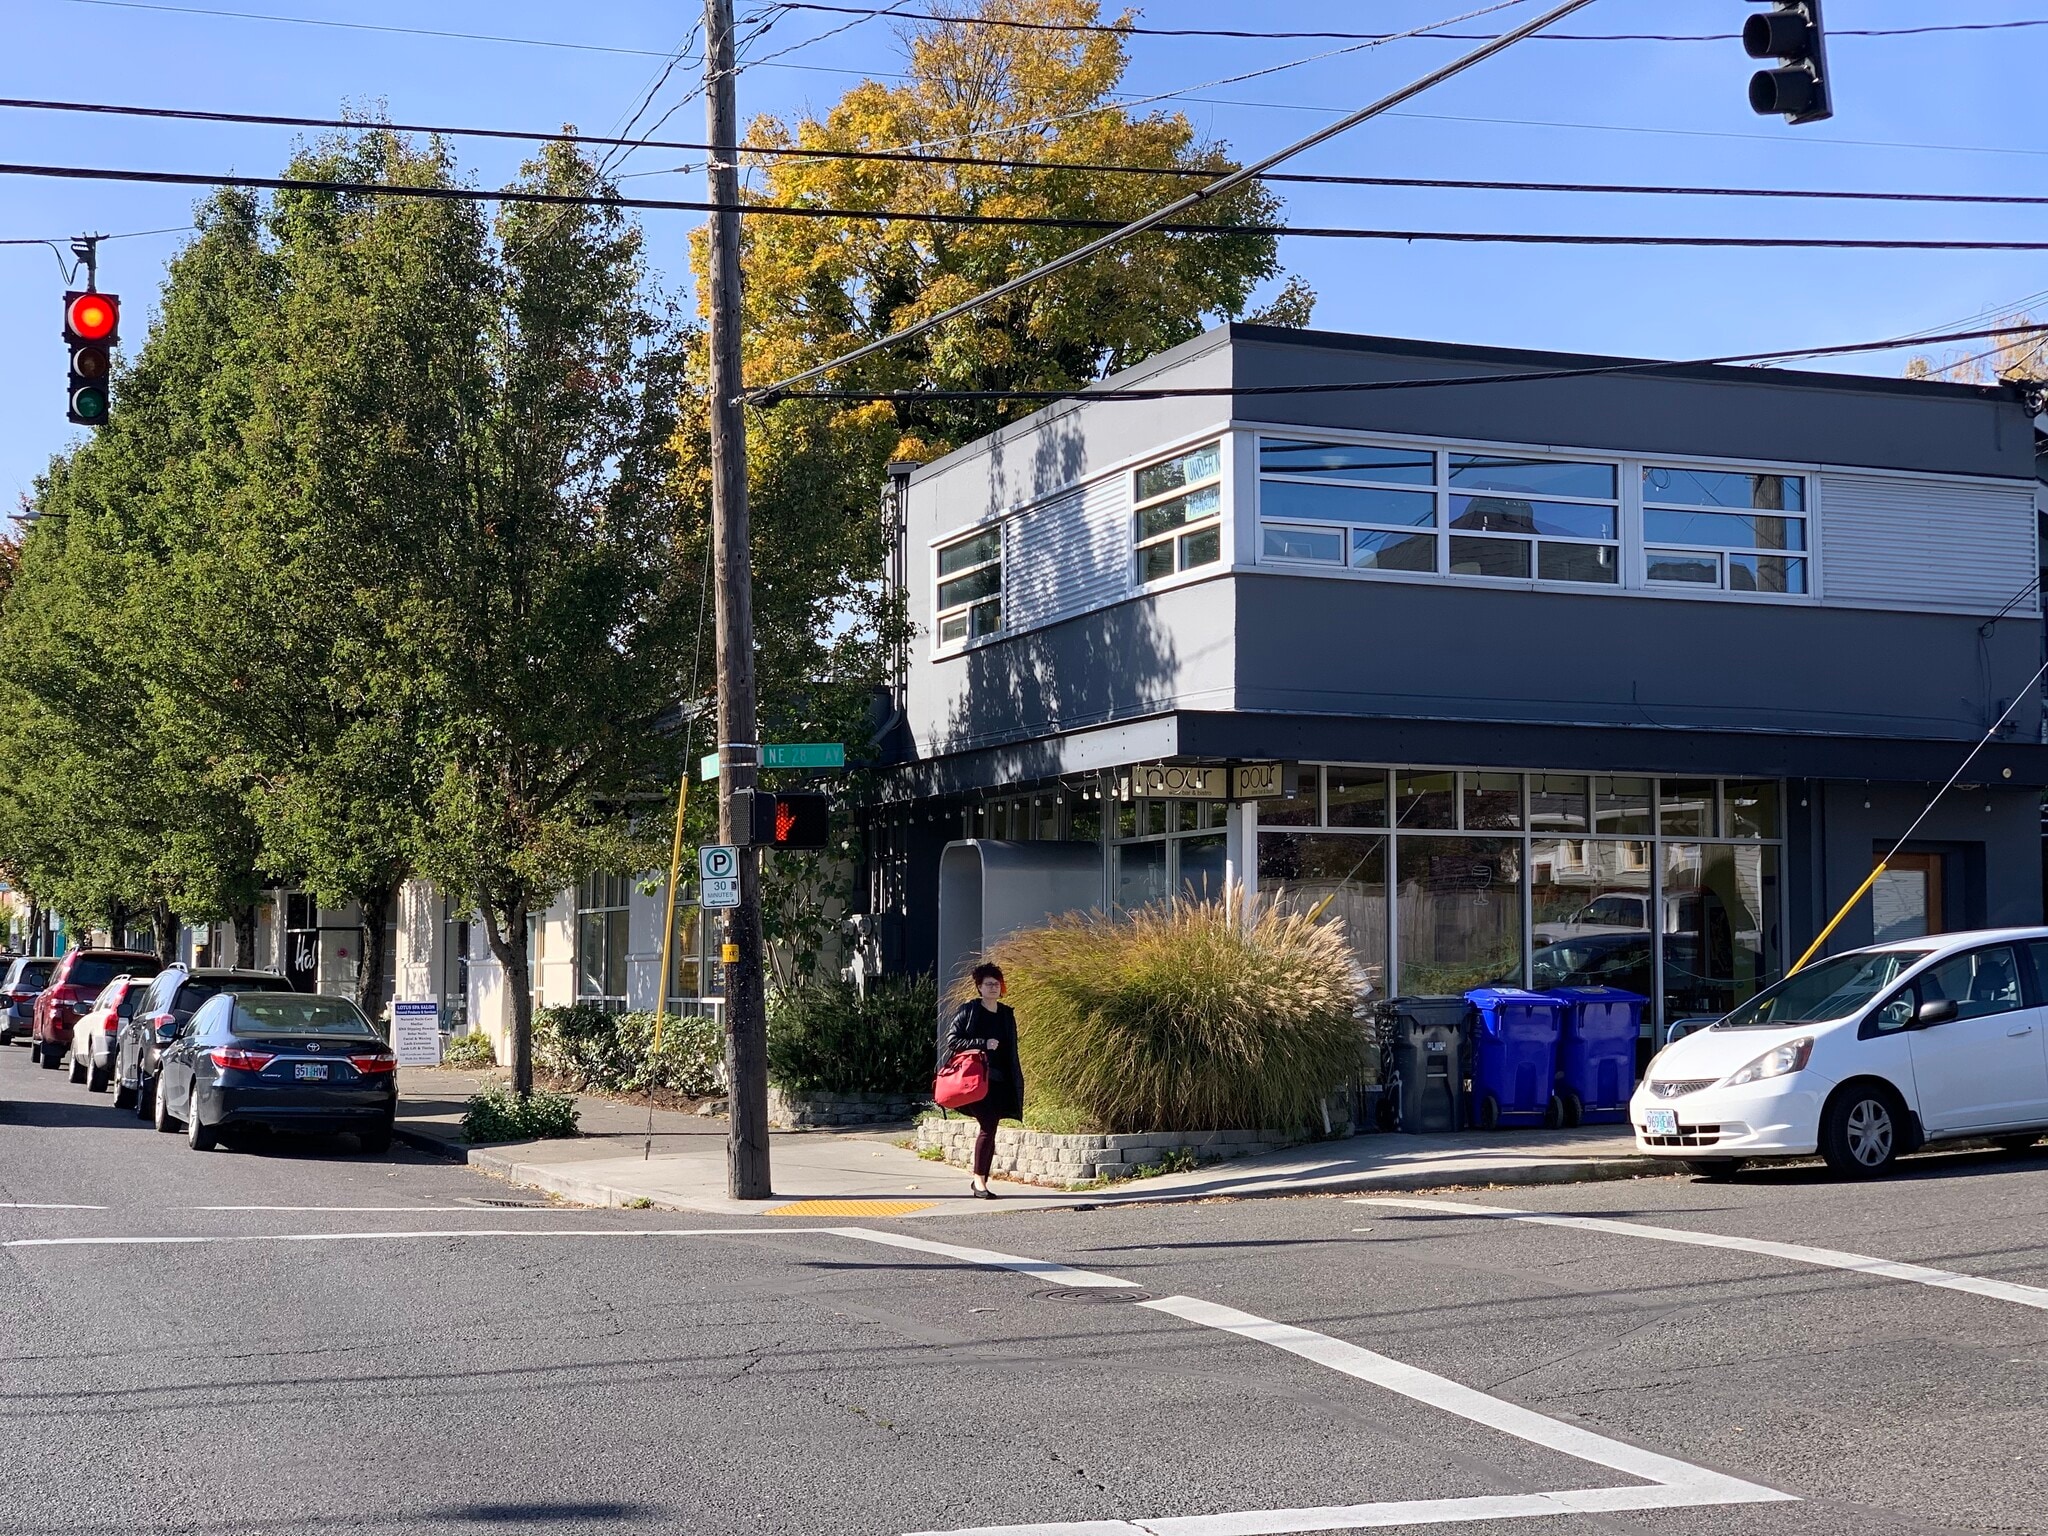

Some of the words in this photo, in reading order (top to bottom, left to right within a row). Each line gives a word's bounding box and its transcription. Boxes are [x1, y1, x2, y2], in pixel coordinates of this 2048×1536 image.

[1187, 454, 1214, 481] UNDER
[769, 748, 785, 764] NE
[824, 747, 841, 762] AV
[1146, 768, 1212, 796] pour
[1240, 766, 1275, 796] pour
[713, 854, 727, 872] P
[713, 881, 727, 891] 30
[295, 1066, 309, 1076] 351
